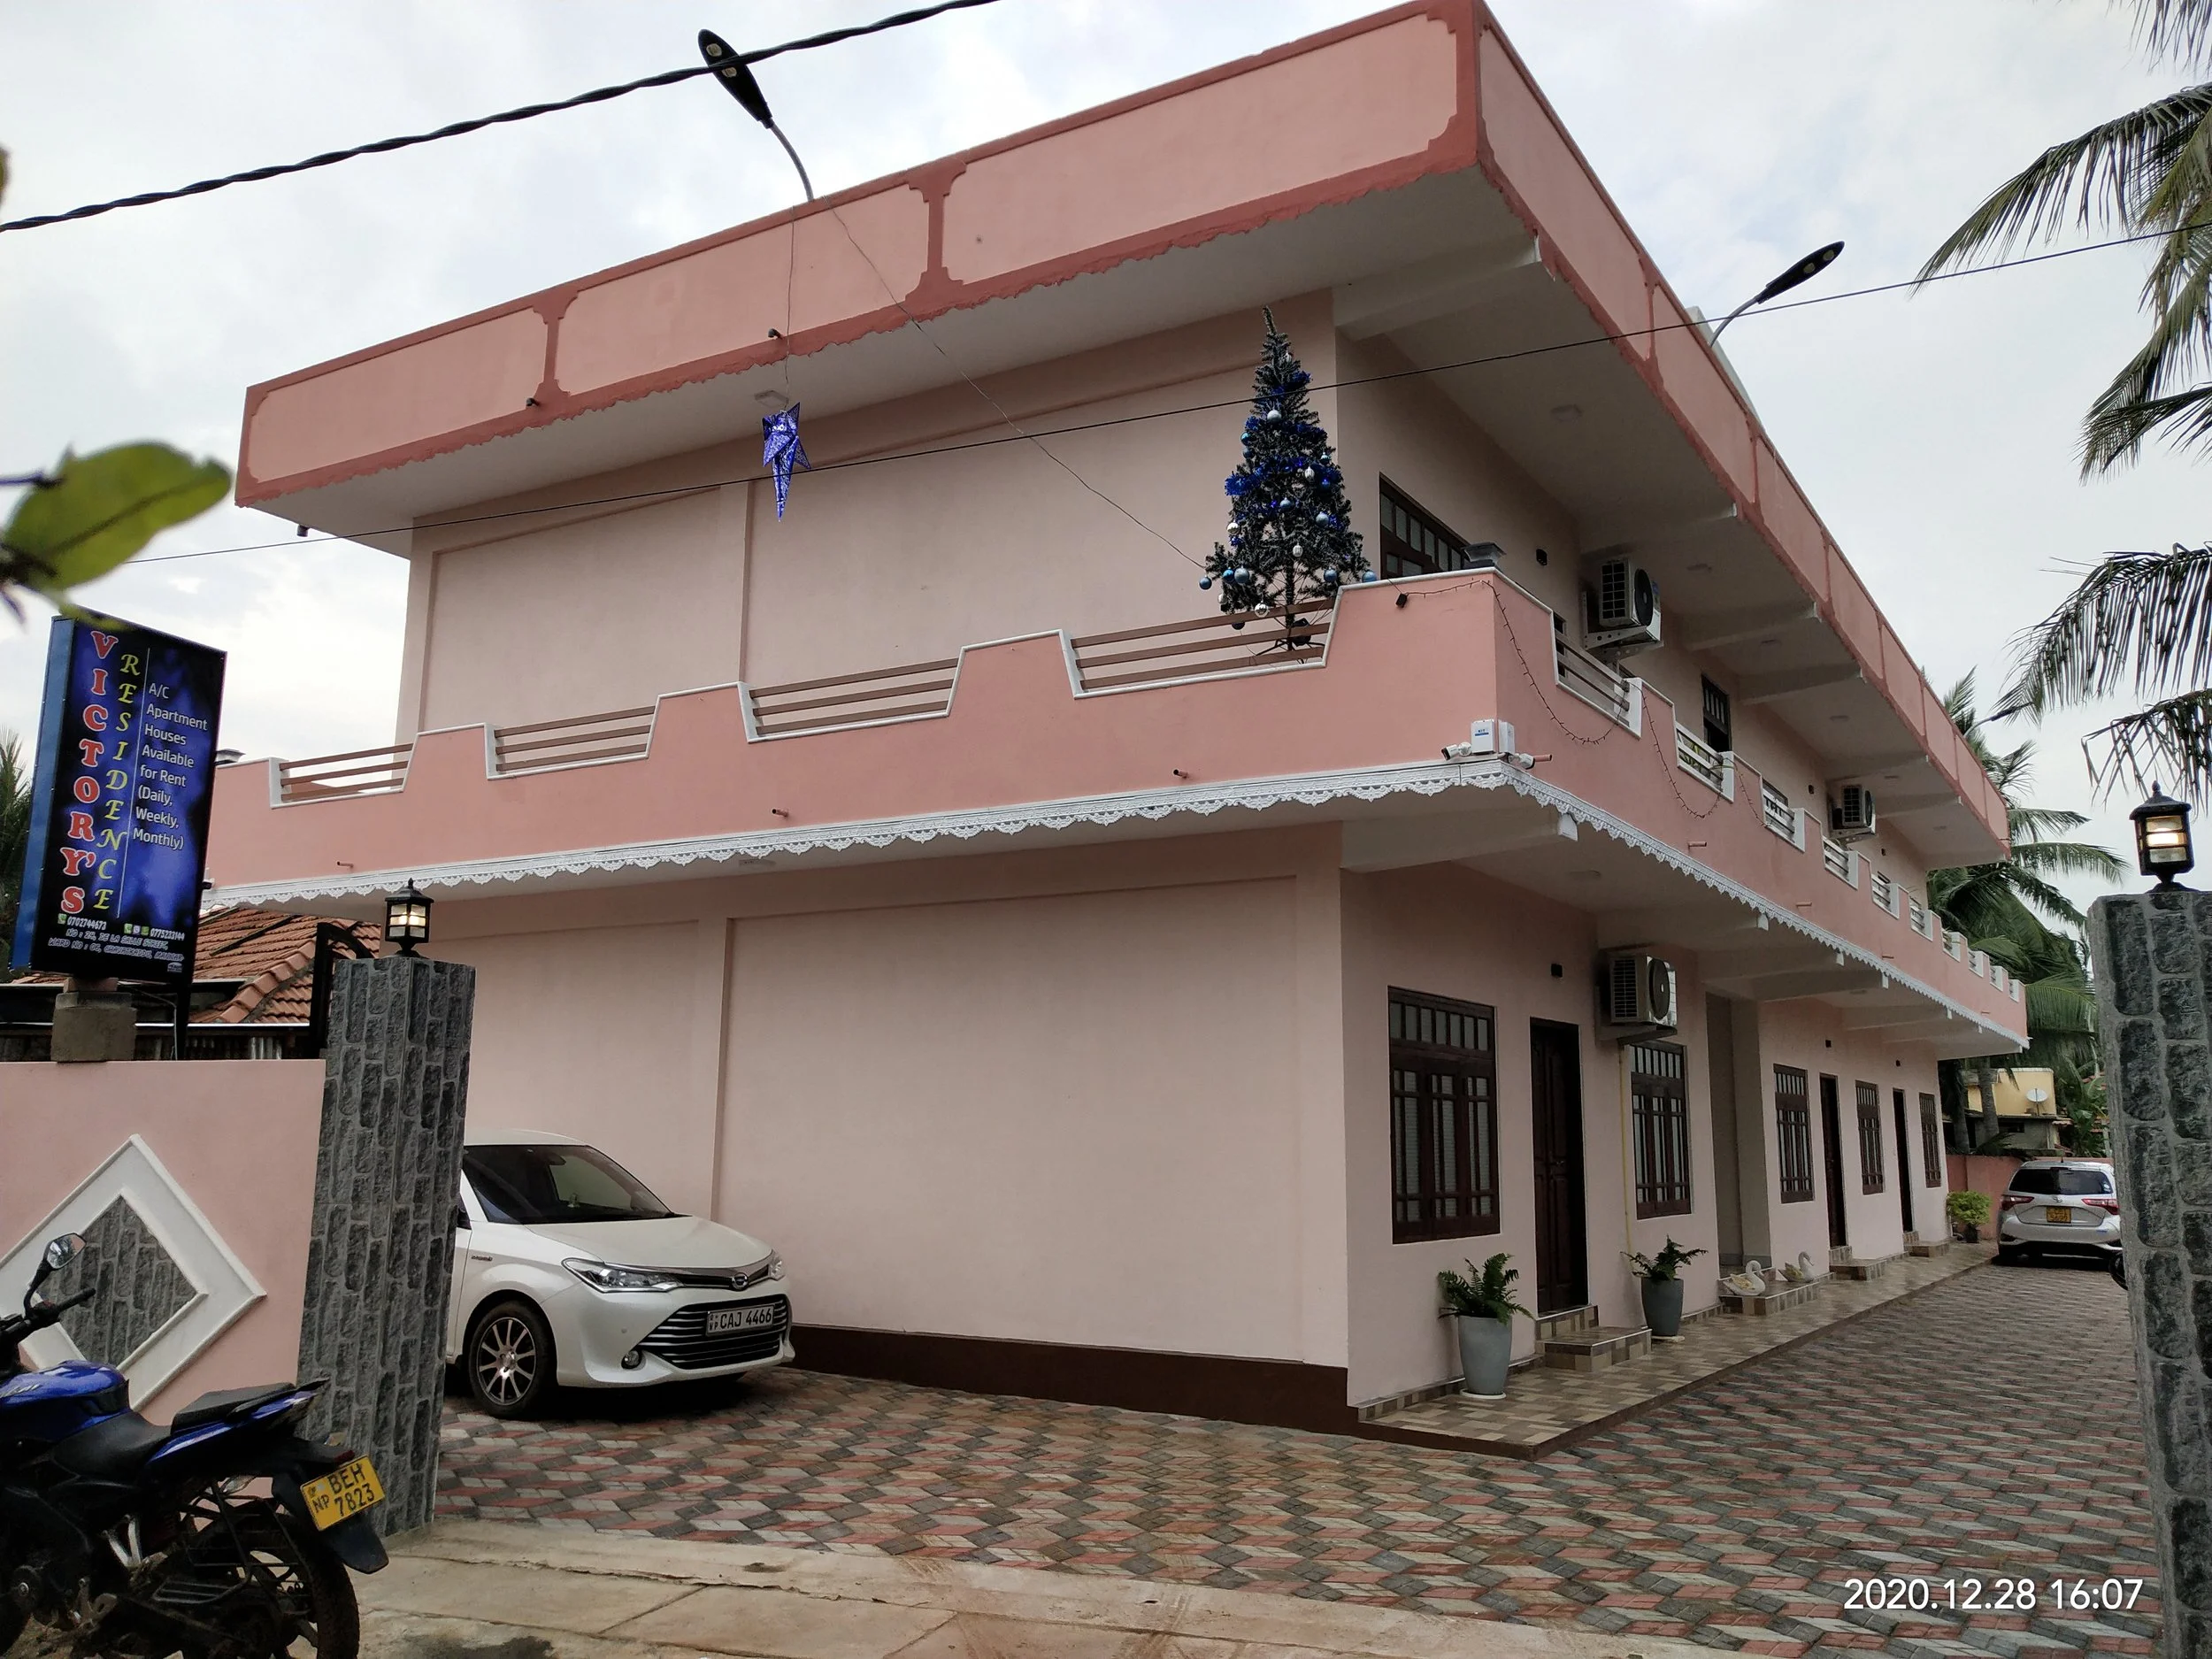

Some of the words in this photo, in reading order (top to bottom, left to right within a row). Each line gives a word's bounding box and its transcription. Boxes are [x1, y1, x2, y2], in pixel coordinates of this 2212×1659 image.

[149, 683, 170, 699] A/C
[146, 703, 208, 731] Apartment
[144, 724, 187, 745] Houses
[142, 744, 195, 768] Available
[60, 631, 119, 913] VICTORY'S
[93, 654, 141, 909] RESIDENCE
[140, 764, 157, 780] for
[160, 770, 187, 787] Rent
[138, 785, 173, 807] (Daily,
[135, 806, 179, 828] Weekly,
[133, 827, 184, 850] Monthly)
[720, 1312, 742, 1329] CAJ
[745, 1308, 772, 1325] 4466
[327, 1463, 365, 1494] BEH
[312, 1494, 330, 1513] NP
[334, 1482, 375, 1517] 7823
